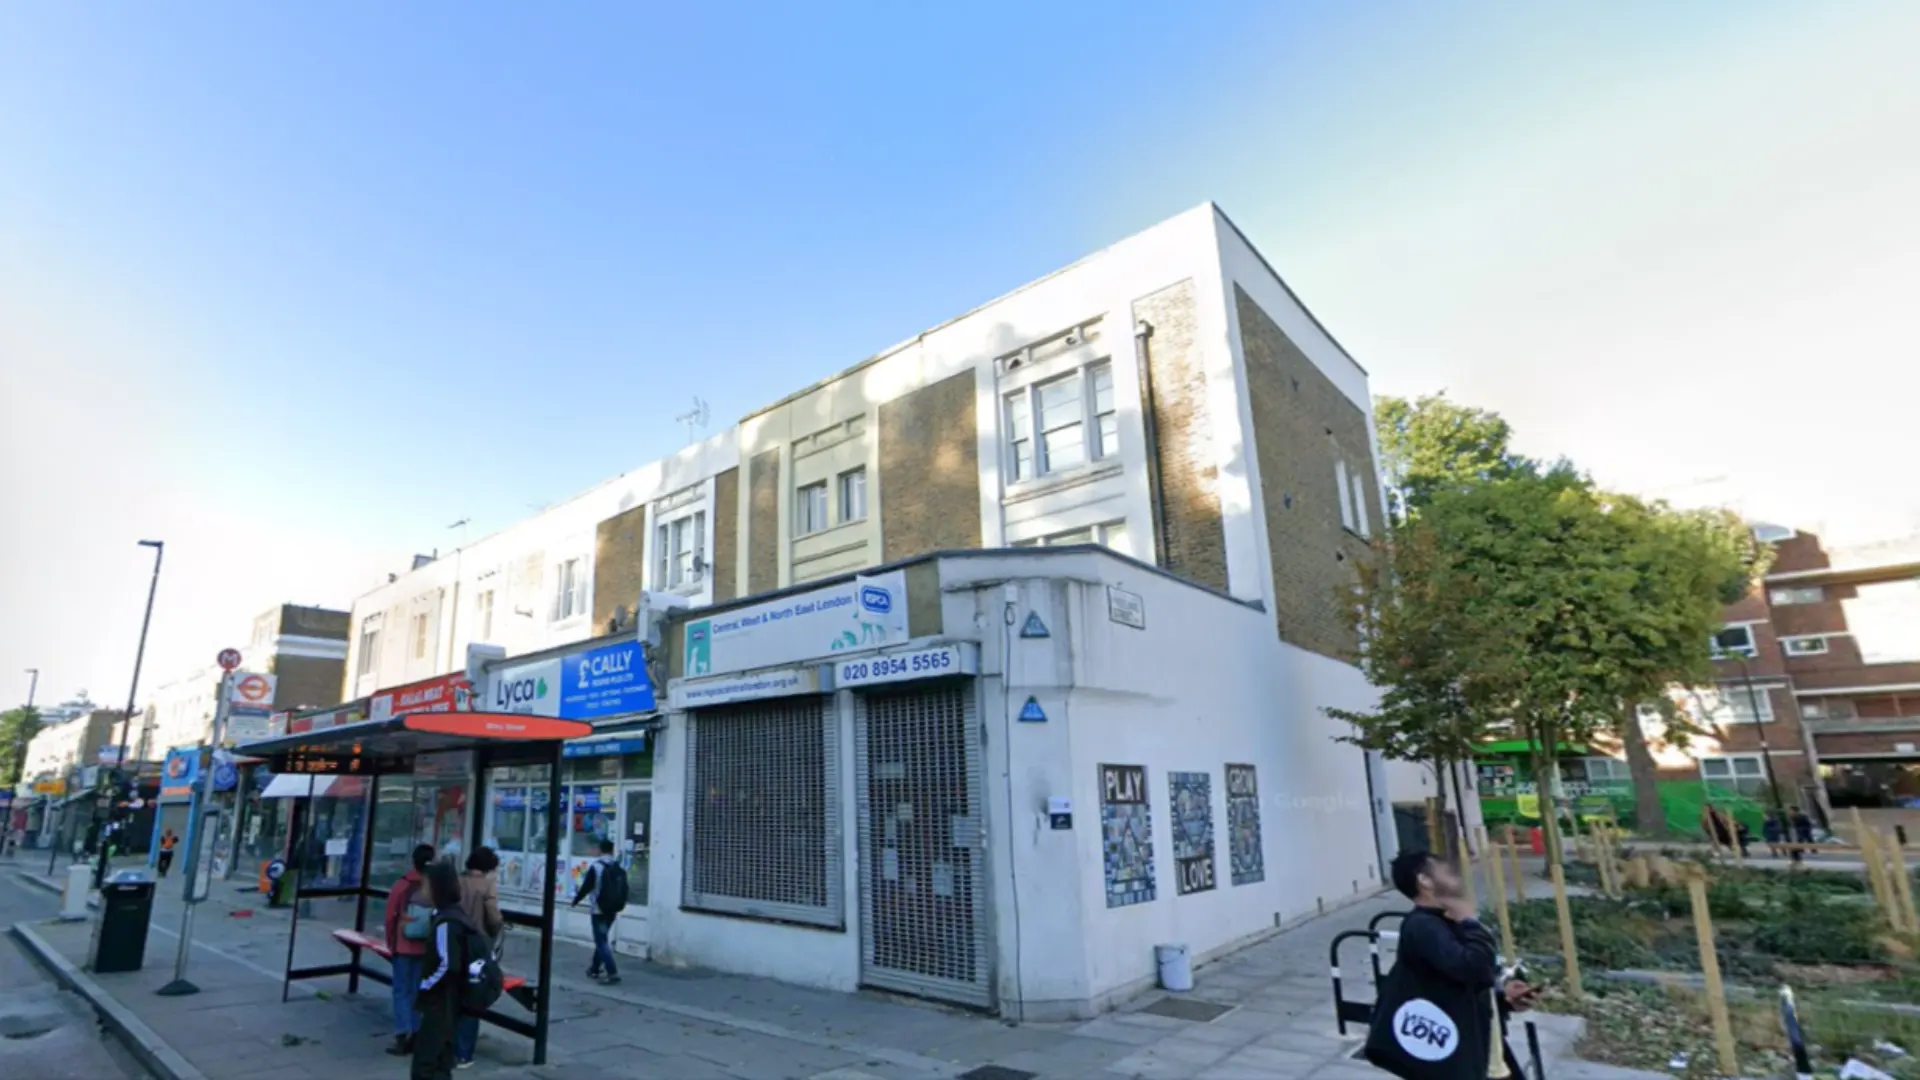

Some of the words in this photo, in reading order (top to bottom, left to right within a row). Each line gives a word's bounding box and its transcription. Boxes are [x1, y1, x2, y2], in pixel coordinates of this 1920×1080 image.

[741, 614, 761, 627] West
[762, 611, 769, 623] &
[769, 605, 794, 621] North
[795, 603, 816, 616] East
[816, 595, 853, 612] London
[591, 650, 633, 676] CALLY
[843, 663, 868, 681] 020
[872, 659, 907, 677] 8954
[911, 651, 951, 672] 5565
[496, 678, 536, 710] Lyca
[1105, 769, 1142, 801] PLAY
[1181, 858, 1214, 892] LOVE
